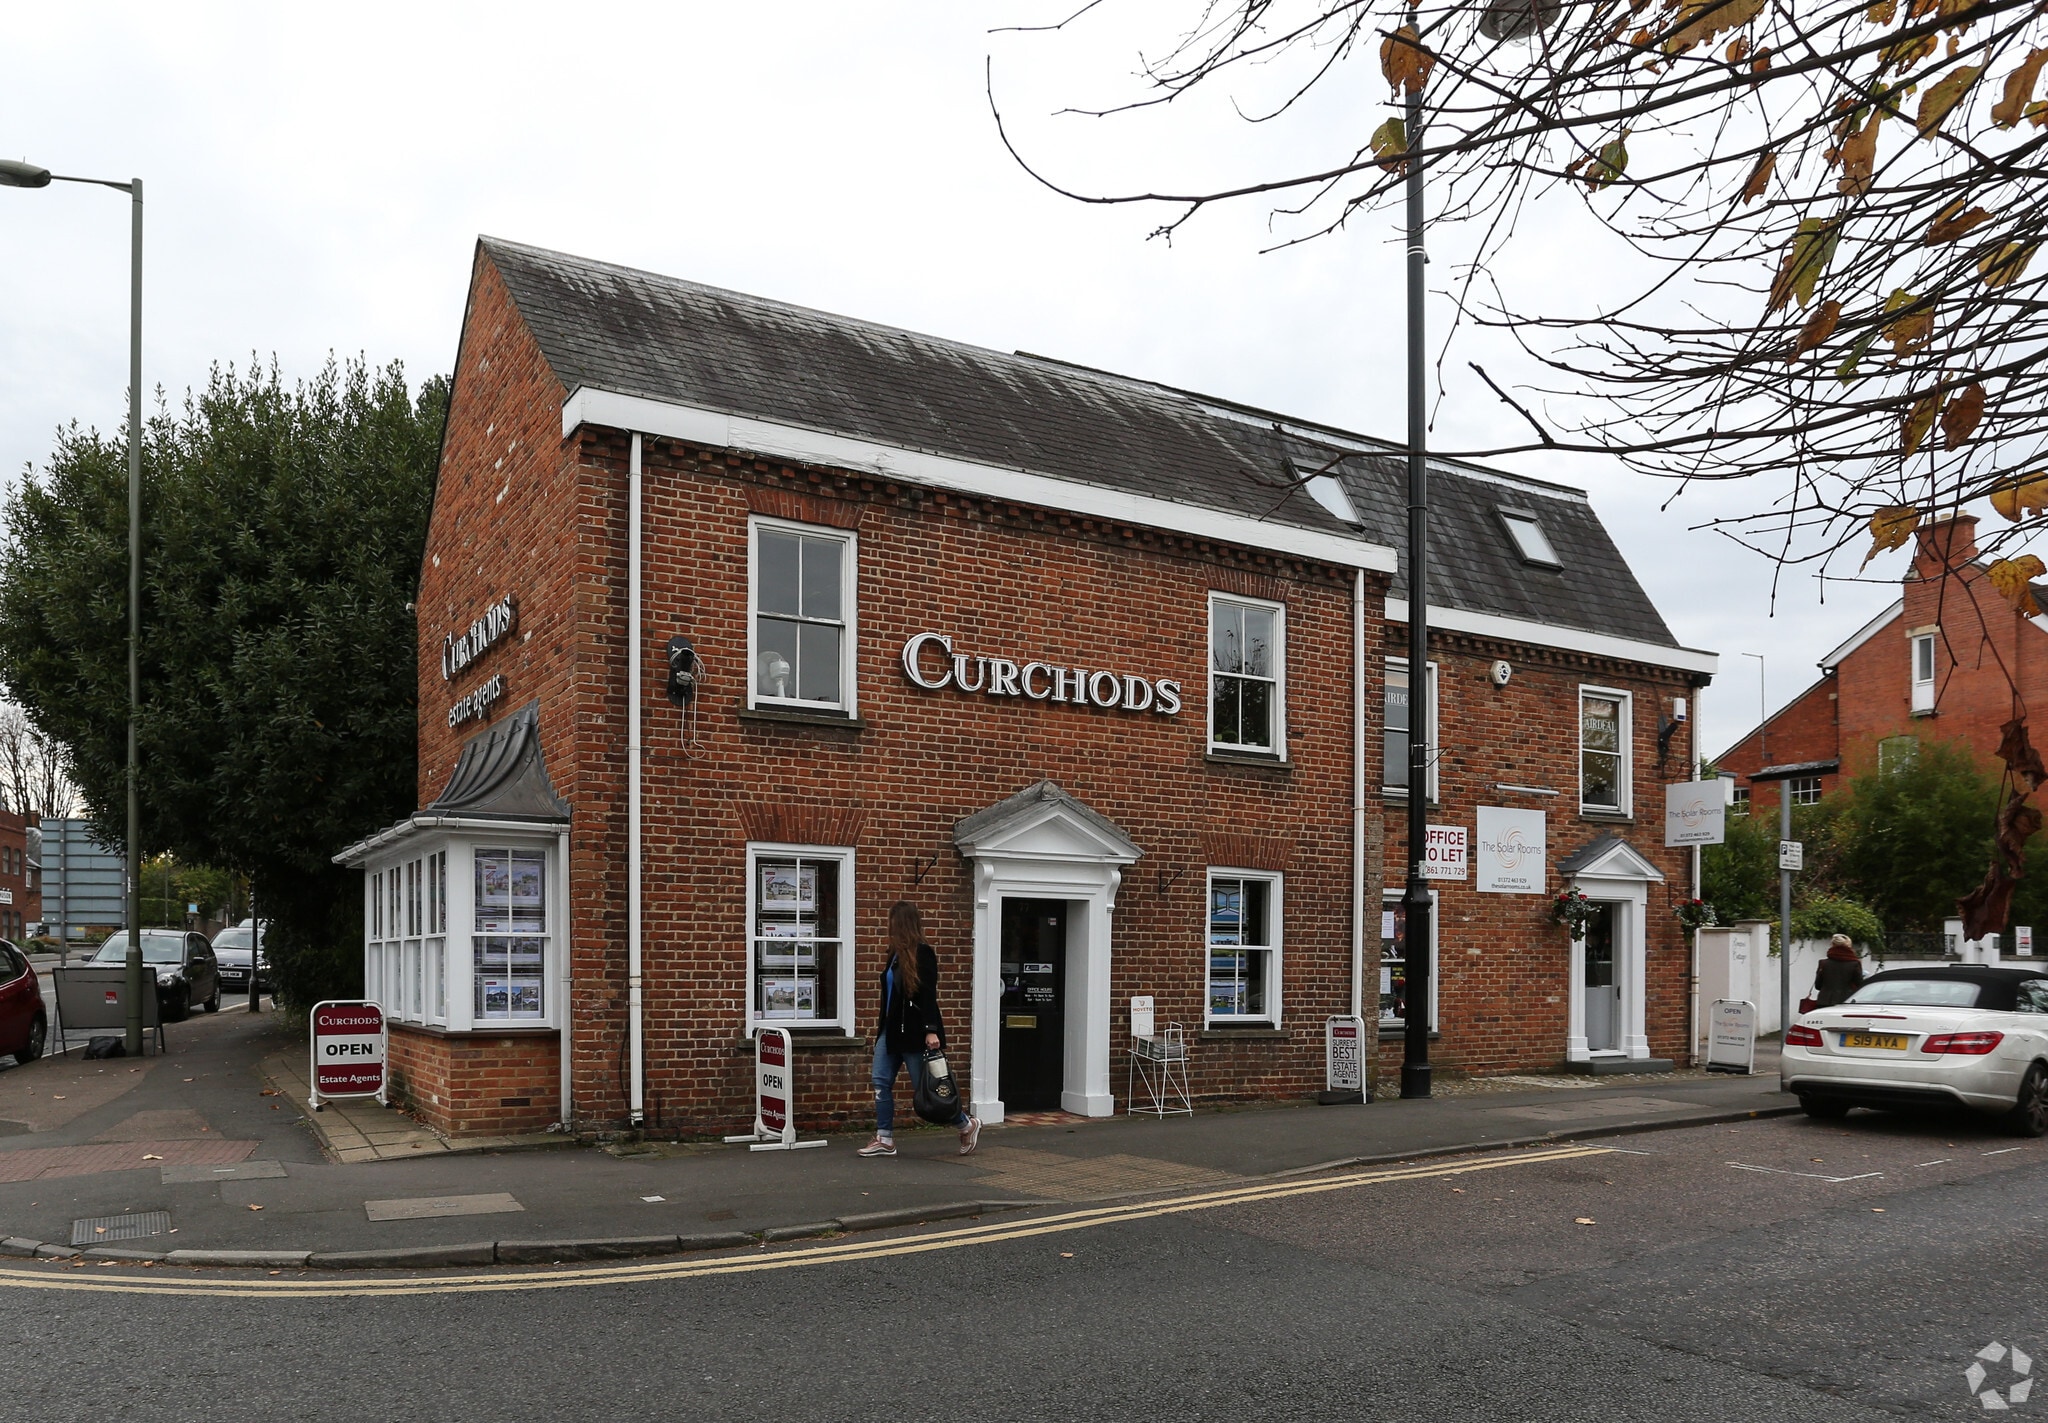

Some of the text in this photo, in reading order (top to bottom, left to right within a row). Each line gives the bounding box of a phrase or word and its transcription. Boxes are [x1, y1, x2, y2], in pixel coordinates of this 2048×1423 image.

[902, 632, 1182, 715] CURCHODS
[448, 673, 501, 728] estate agents
[1385, 692, 1408, 705] IRDE
[1482, 841, 1541, 855] The Solar Rooms
[1441, 848, 1463, 862] LET
[1426, 865, 1466, 876] 861 771 729
[319, 1015, 379, 1026] CURCHODS
[760, 1042, 785, 1055] CURCHODS
[1875, 1037, 1898, 1048] AYA
[326, 1043, 373, 1056] OPEN
[1332, 1047, 1357, 1059] BEST
[1332, 1062, 1357, 1071] ESTATE
[319, 1074, 380, 1084] Estate Agents
[1333, 1071, 1358, 1079] AGENTS
[763, 1074, 783, 1090] OPEN
[761, 1106, 773, 1116] Estate
